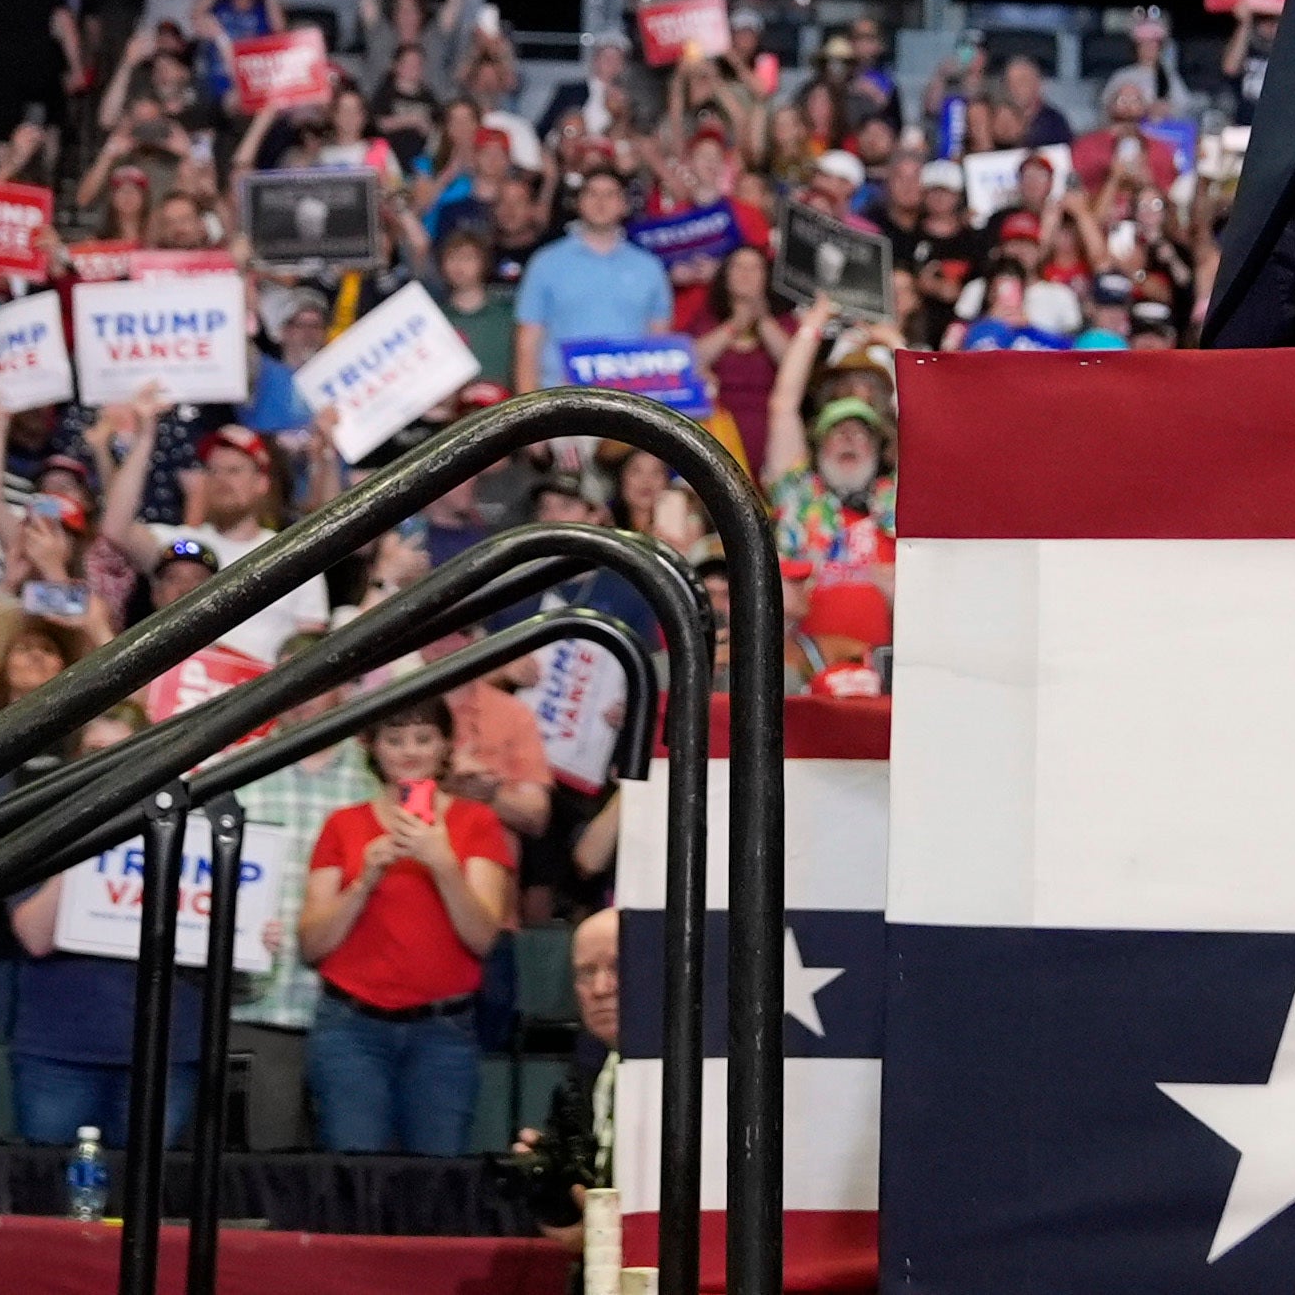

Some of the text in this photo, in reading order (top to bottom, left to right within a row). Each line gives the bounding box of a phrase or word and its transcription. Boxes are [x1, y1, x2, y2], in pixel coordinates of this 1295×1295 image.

[92, 308, 227, 337] TRUMP
[109, 339, 211, 361] VANCE
[320, 313, 427, 398] TRUMP
[568, 348, 690, 382] TRUMP
[95, 847, 262, 887] TRMP
[107, 879, 212, 917] VAC
